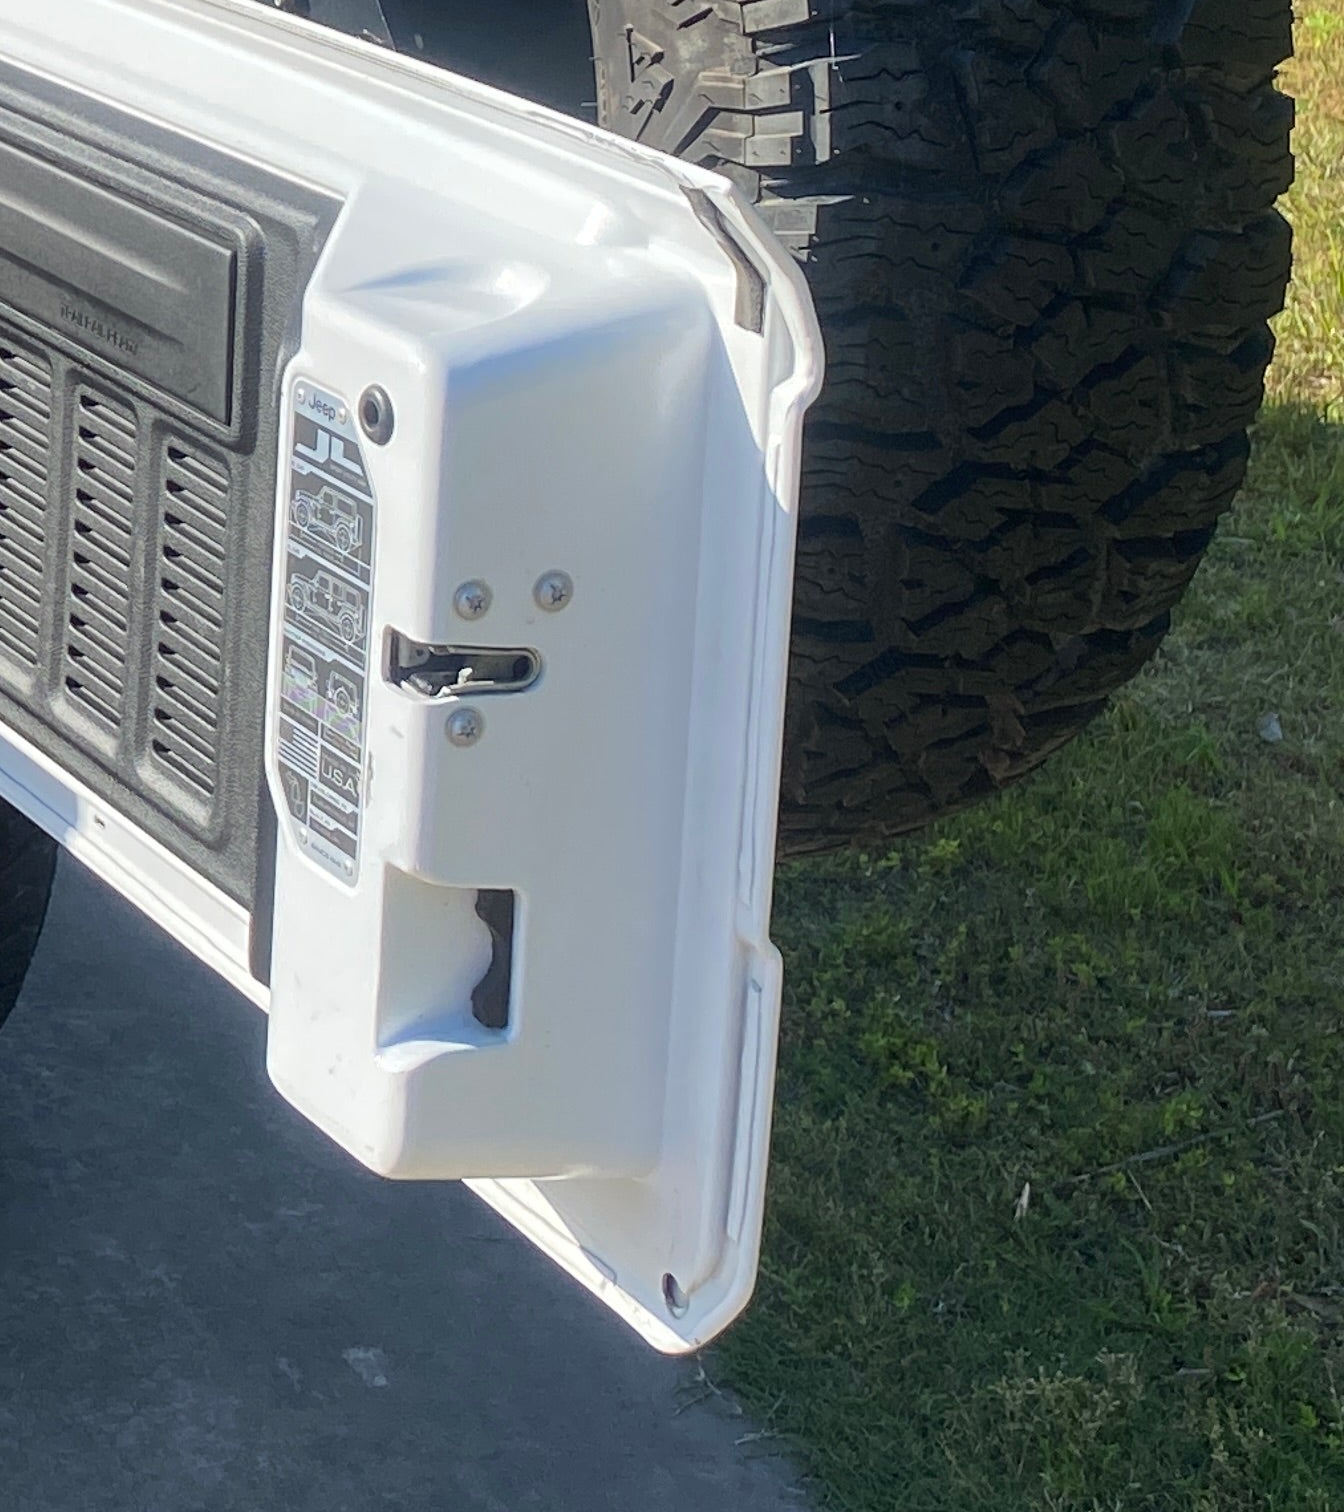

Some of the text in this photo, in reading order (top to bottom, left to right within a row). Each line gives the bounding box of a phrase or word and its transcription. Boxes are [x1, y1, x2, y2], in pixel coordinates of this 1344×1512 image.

[308, 393, 336, 423] Jeep
[294, 428, 364, 477] JL
[320, 760, 358, 798] USA
